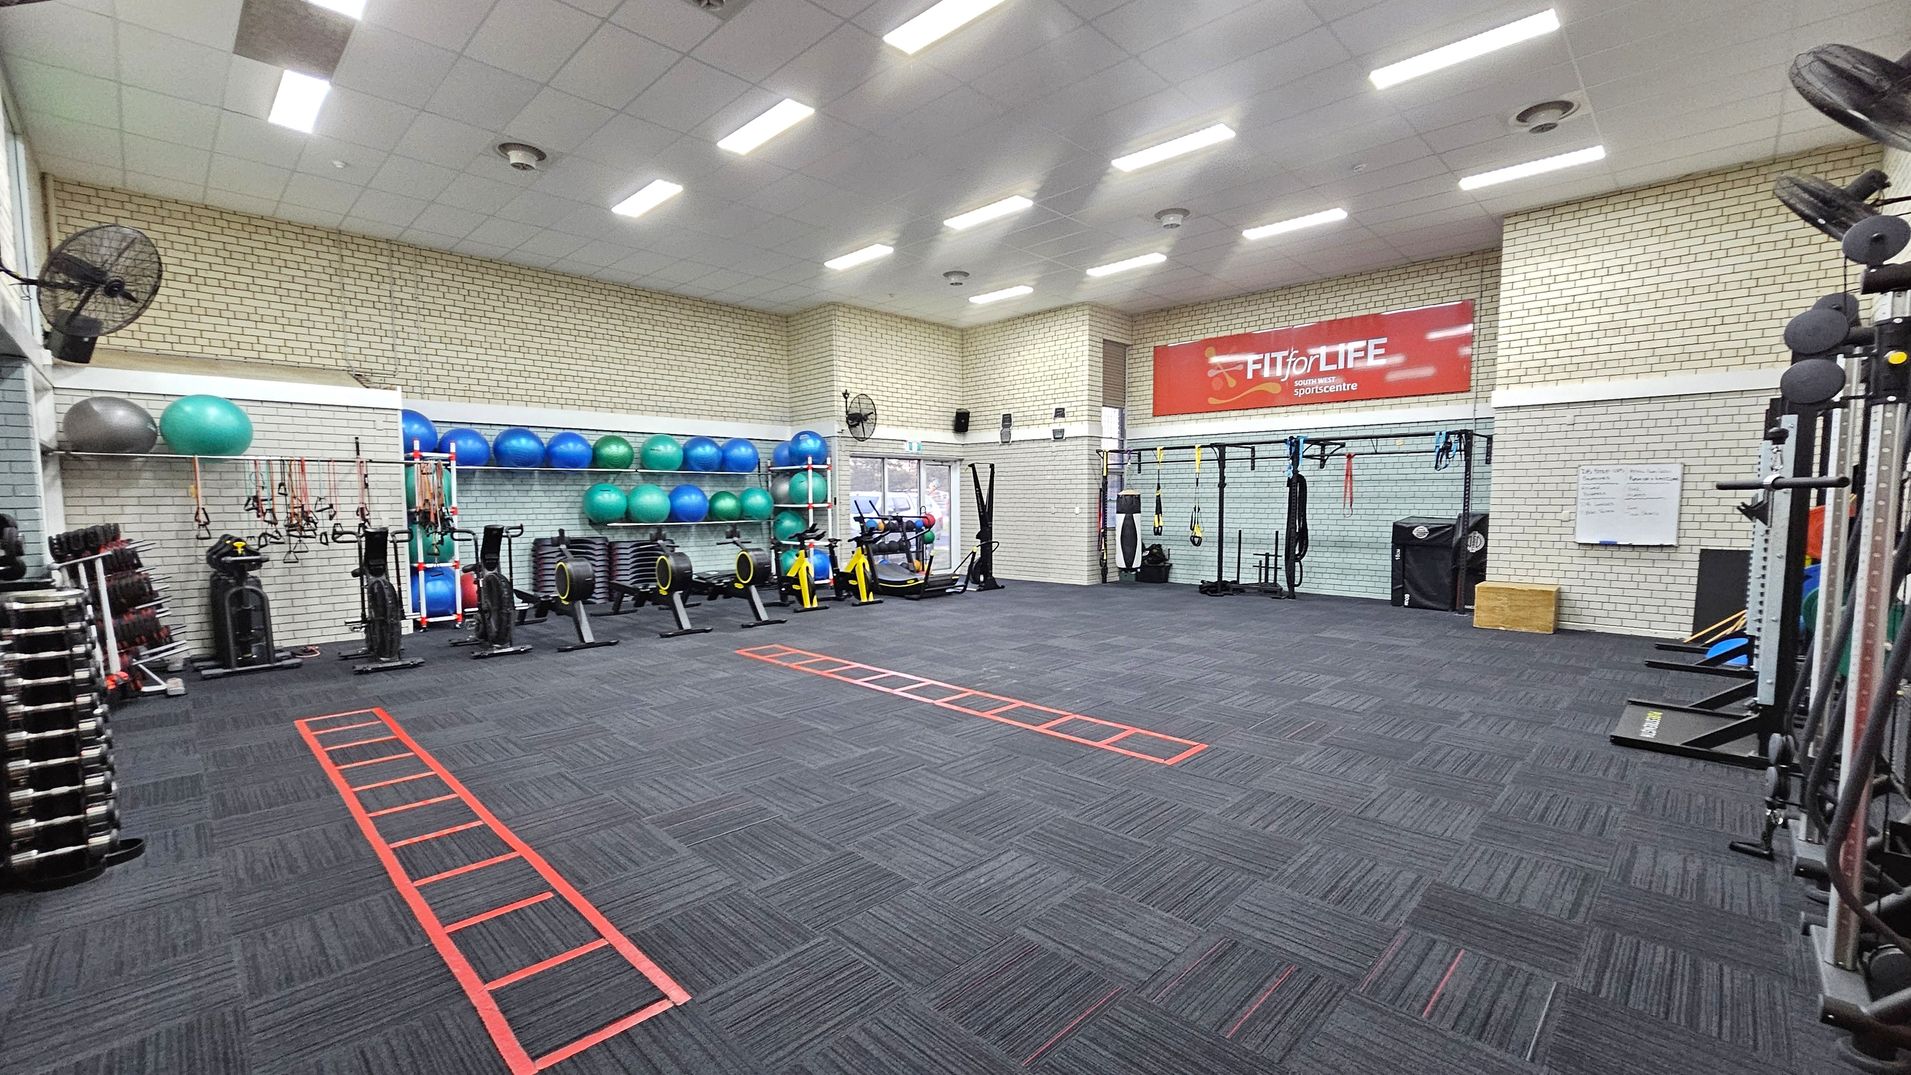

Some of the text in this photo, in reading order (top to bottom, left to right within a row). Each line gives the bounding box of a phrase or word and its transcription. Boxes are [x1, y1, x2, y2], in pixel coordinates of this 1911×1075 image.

[1294, 376, 1337, 387] SOUTH WEST
[1293, 382, 1358, 397] sportscentre
